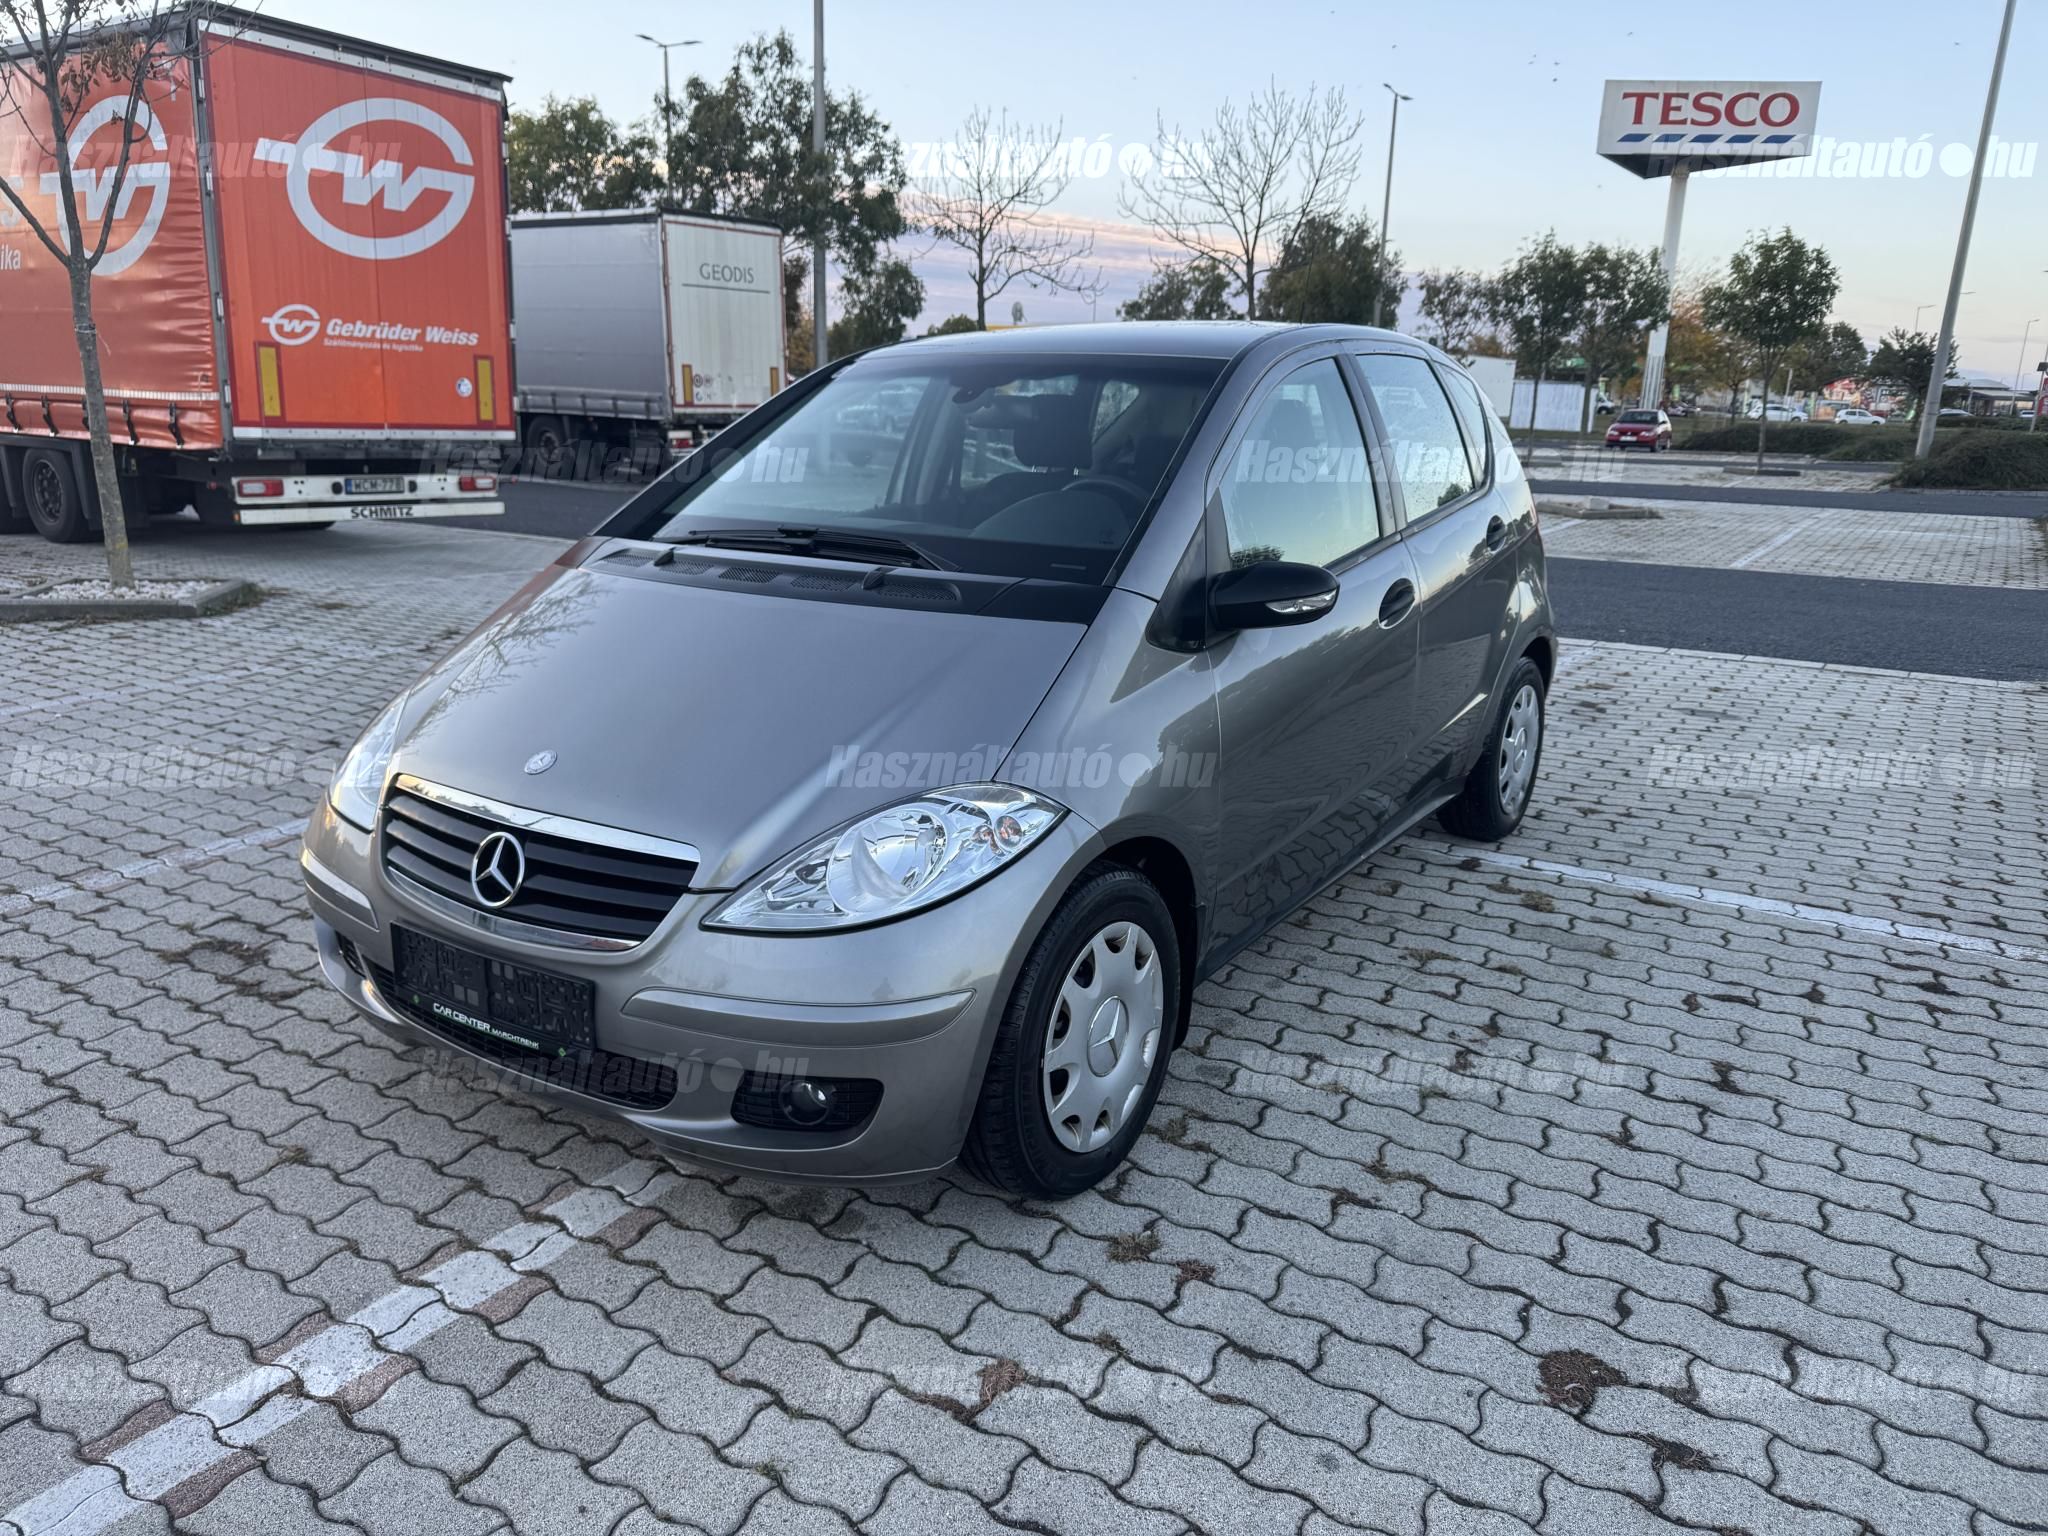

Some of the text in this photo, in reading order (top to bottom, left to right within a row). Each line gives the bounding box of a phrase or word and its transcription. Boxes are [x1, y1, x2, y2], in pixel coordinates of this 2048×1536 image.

[1622, 91, 1800, 127] TESCO
[699, 262, 755, 284] GEODIS
[326, 318, 479, 346] Gebrüder Weiss
[350, 504, 414, 519] SCHMITZ
[433, 1002, 540, 1050] CAR CENTER MARCHTRENK
